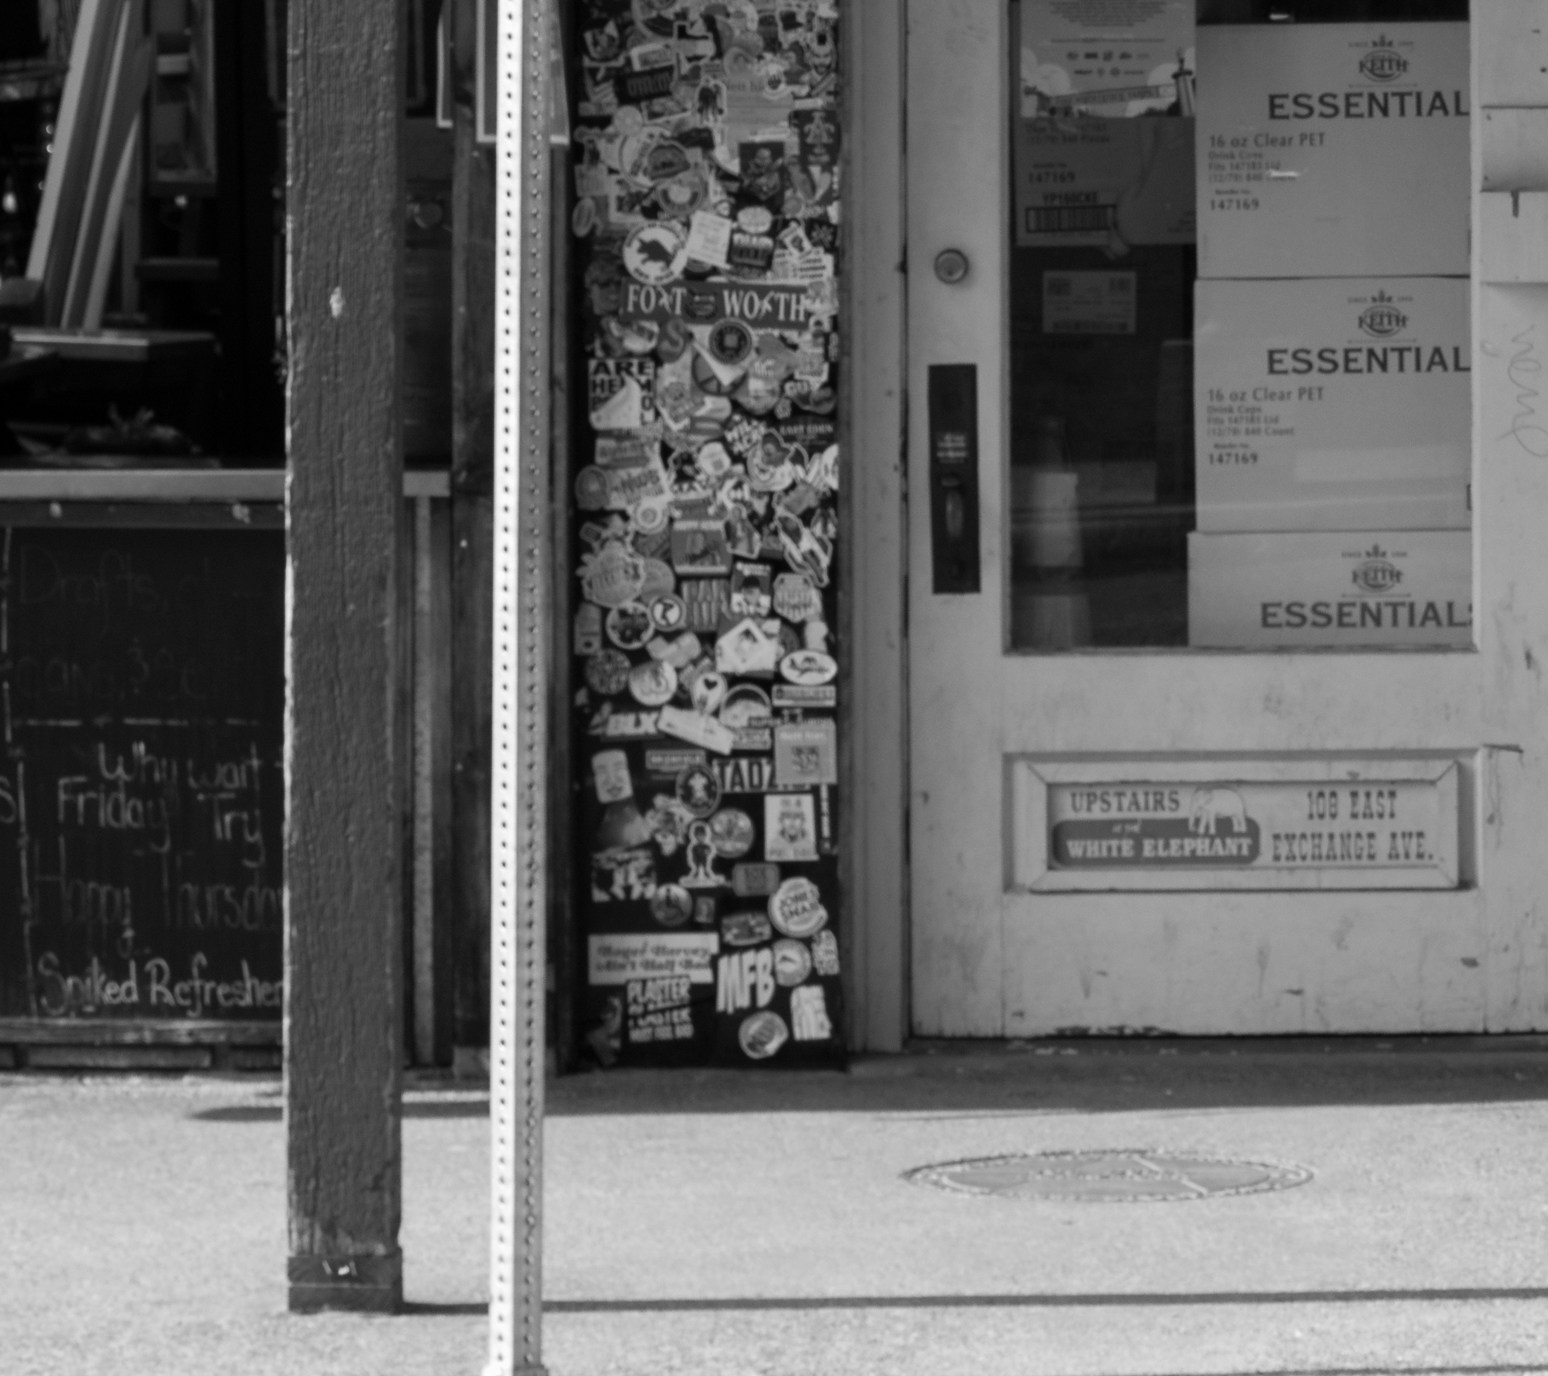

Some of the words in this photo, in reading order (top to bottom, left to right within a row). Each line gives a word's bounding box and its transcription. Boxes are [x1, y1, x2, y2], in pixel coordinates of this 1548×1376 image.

[1210, 133, 1225, 148] 16
[1231, 133, 1248, 148] oz
[1254, 133, 1293, 148] Clear
[1299, 133, 1325, 148] PET
[1210, 198, 1259, 211] 147169
[1208, 387, 1224, 402] 16
[1229, 387, 1247, 402] oz
[1252, 387, 1292, 402] Clear
[1297, 387, 1324, 402] PET
[1208, 453, 1258, 465] 147169
[59, 775, 170, 854] Friday
[1070, 790, 1180, 813] UPSTAIRS
[1306, 790, 1339, 820] 108
[1349, 790, 1397, 819] EAST
[1066, 838, 1136, 858] WHITE
[1142, 836, 1252, 857] ELEPHANT
[1271, 832, 1377, 862] EXCHANGE
[1387, 831, 1434, 860] AVE.
[38, 951, 139, 1018] Spiked
